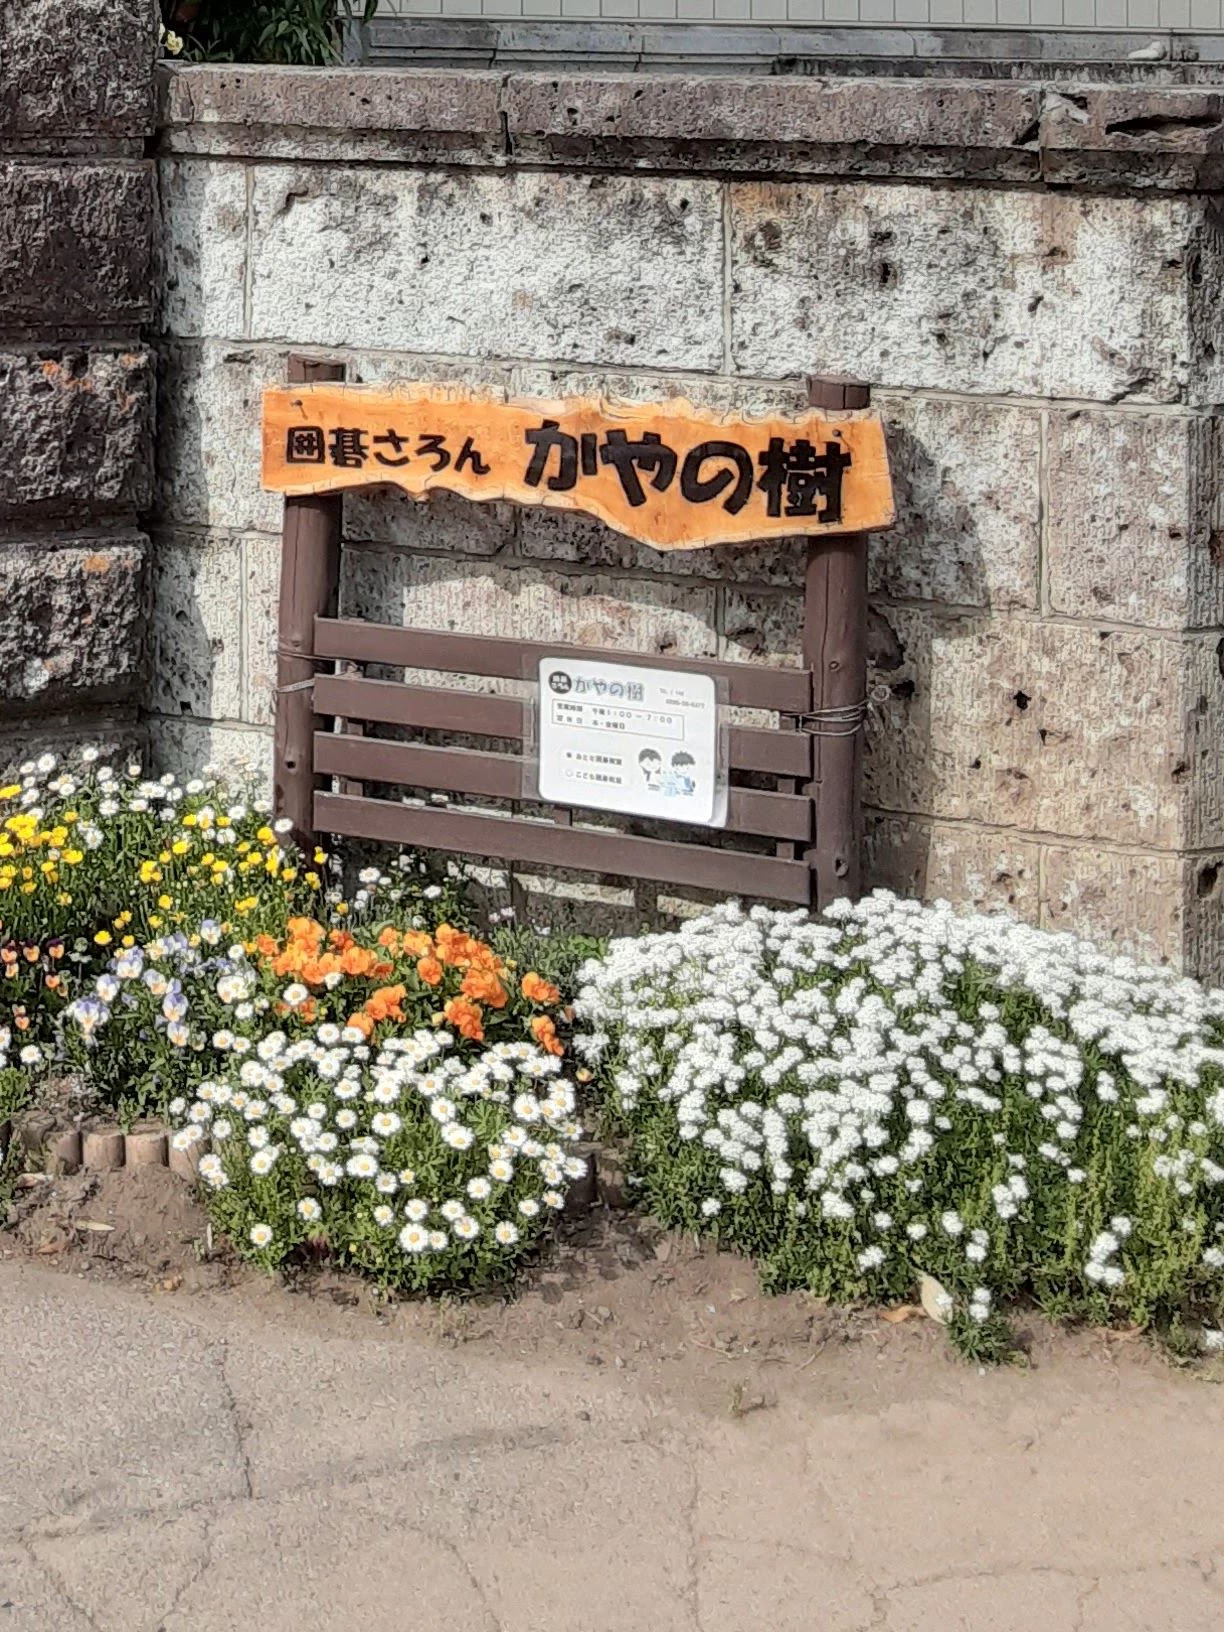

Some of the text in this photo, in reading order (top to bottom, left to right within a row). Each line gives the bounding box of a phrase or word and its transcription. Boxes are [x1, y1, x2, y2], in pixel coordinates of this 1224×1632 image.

[286, 419, 853, 524] 囲碁さろん かやの樹
